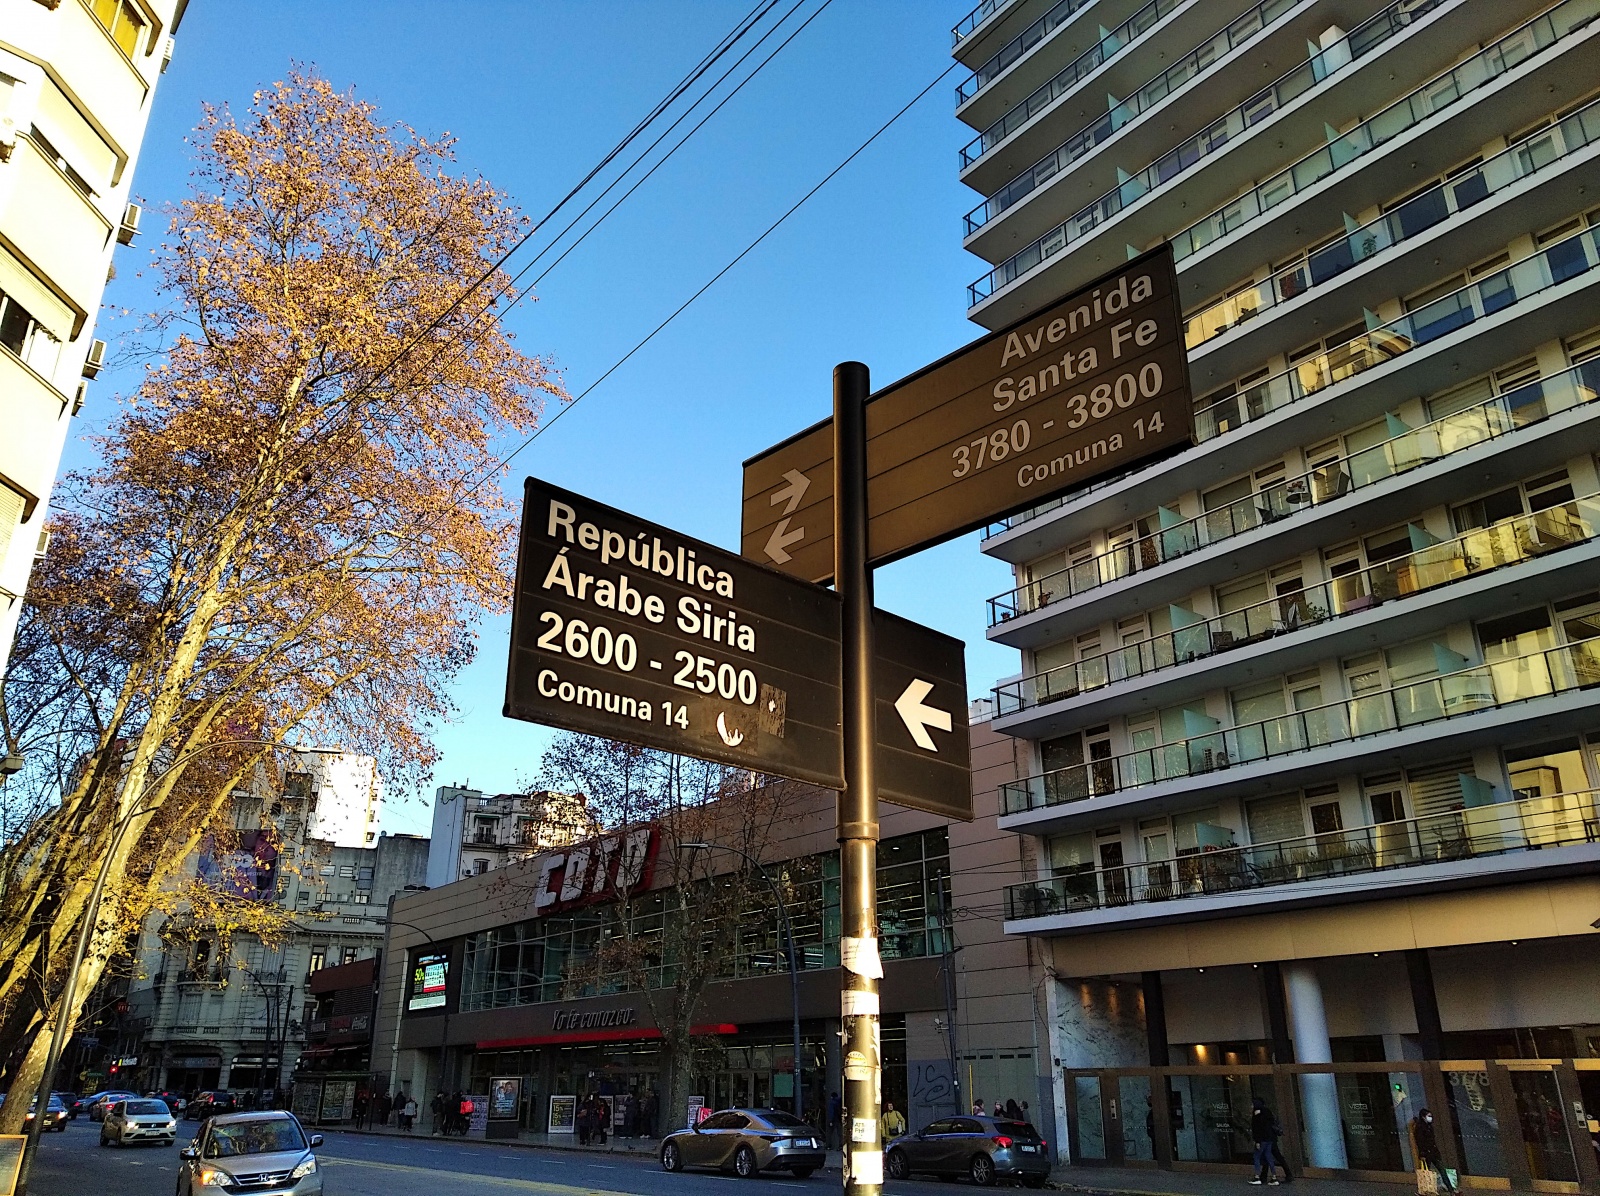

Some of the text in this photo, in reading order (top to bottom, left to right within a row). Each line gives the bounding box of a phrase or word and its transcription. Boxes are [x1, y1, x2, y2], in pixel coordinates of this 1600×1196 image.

[992, 317, 1158, 413] Santa Fe
[1000, 273, 1153, 368] Avenida
[951, 418, 1031, 479] 3780
[1065, 361, 1164, 430] 3800
[1016, 410, 1165, 489] Comuna 14
[547, 499, 735, 599] República
[541, 548, 757, 653] Árabe Siria
[536, 611, 638, 673] 2600
[673, 649, 758, 706] 2500
[537, 668, 689, 731] Comuna 14
[535, 829, 651, 908] COTO
[552, 1009, 566, 1031] Yo
